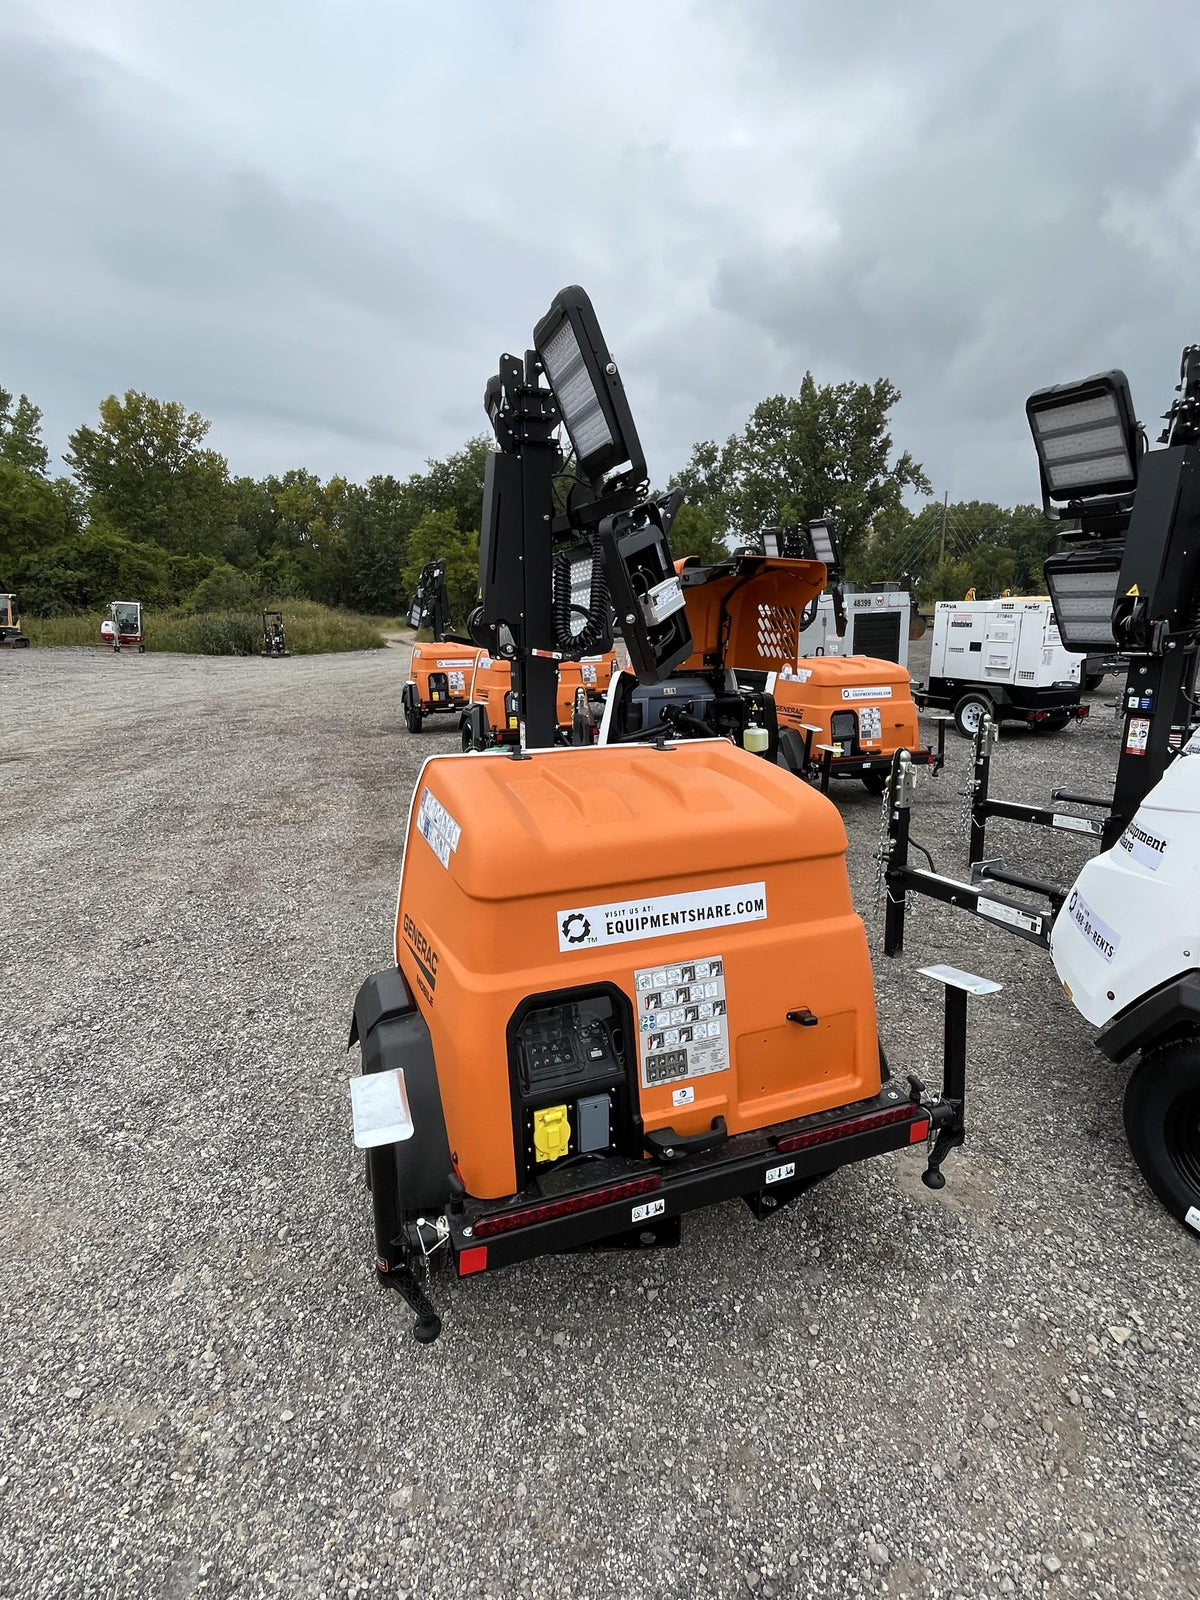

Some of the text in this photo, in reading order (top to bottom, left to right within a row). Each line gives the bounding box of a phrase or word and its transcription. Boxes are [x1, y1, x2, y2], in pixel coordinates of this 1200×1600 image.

[854, 599, 871, 607] 48399
[605, 909, 626, 918] VISIT
[606, 898, 764, 935] EQUIPMENTSHARE.COM
[403, 912, 438, 976] GENERAC
